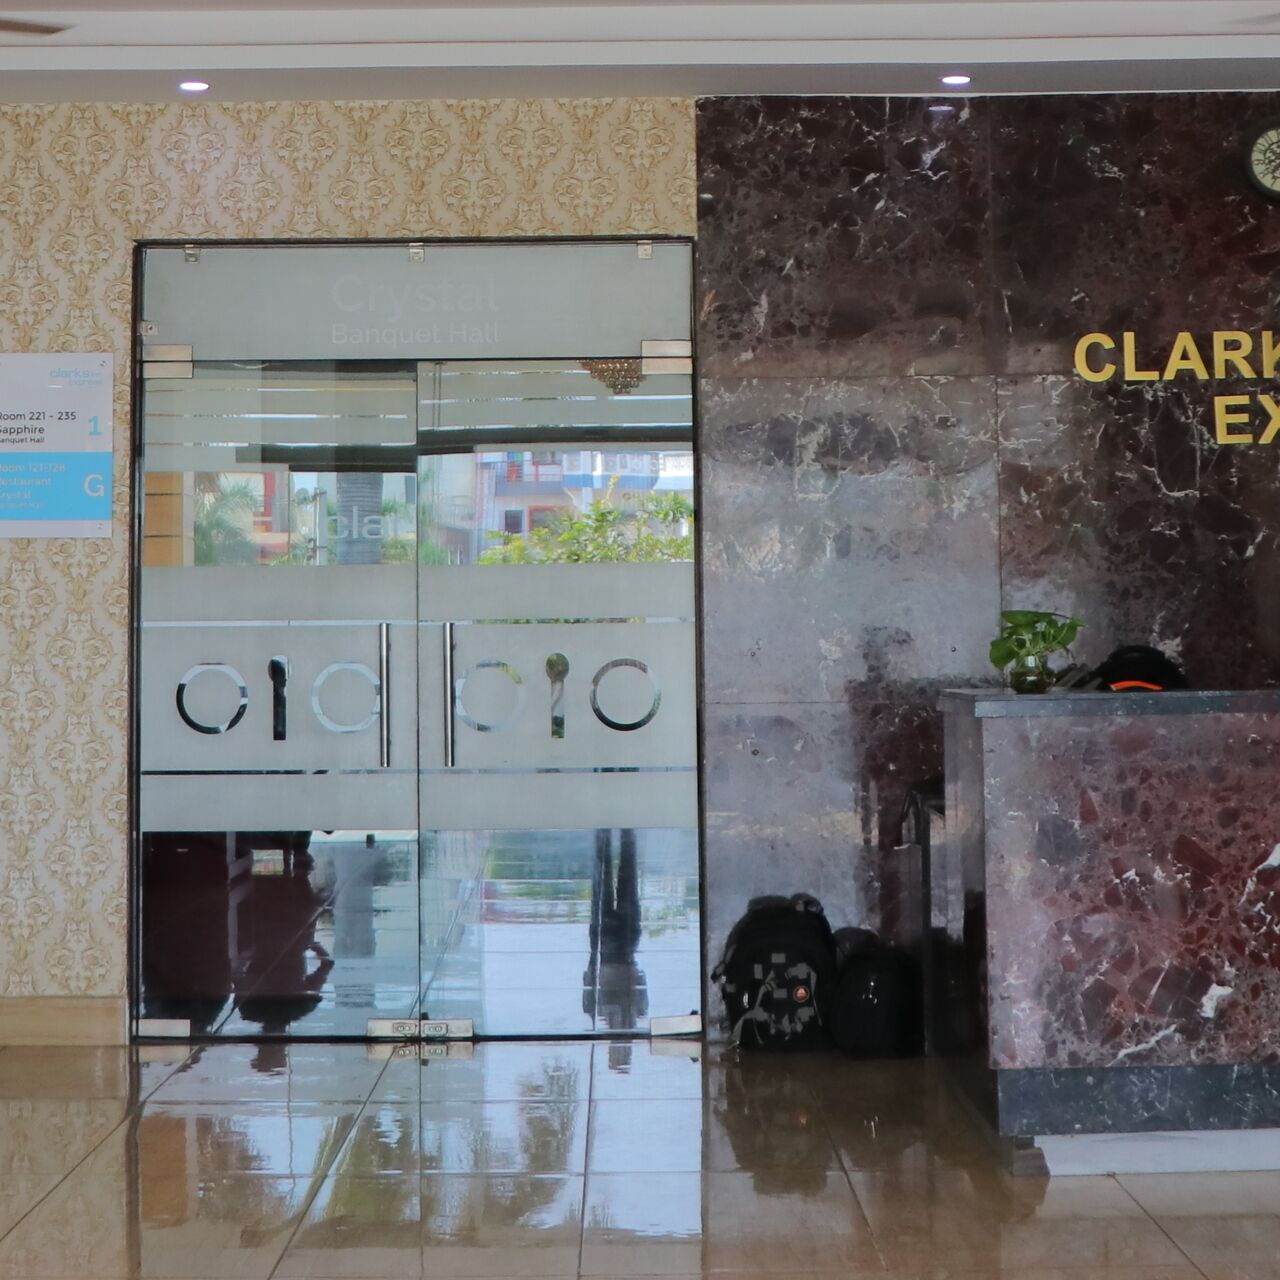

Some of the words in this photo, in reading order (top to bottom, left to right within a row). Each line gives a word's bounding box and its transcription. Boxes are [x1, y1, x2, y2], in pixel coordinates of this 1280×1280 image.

[331, 273, 500, 322] Crystal
[331, 323, 441, 348] Banquet
[449, 322, 500, 343] Hall
[29, 411, 46, 421] 221
[57, 411, 77, 421] 235
[88, 415, 103, 436] 1
[84, 473, 105, 497] G
